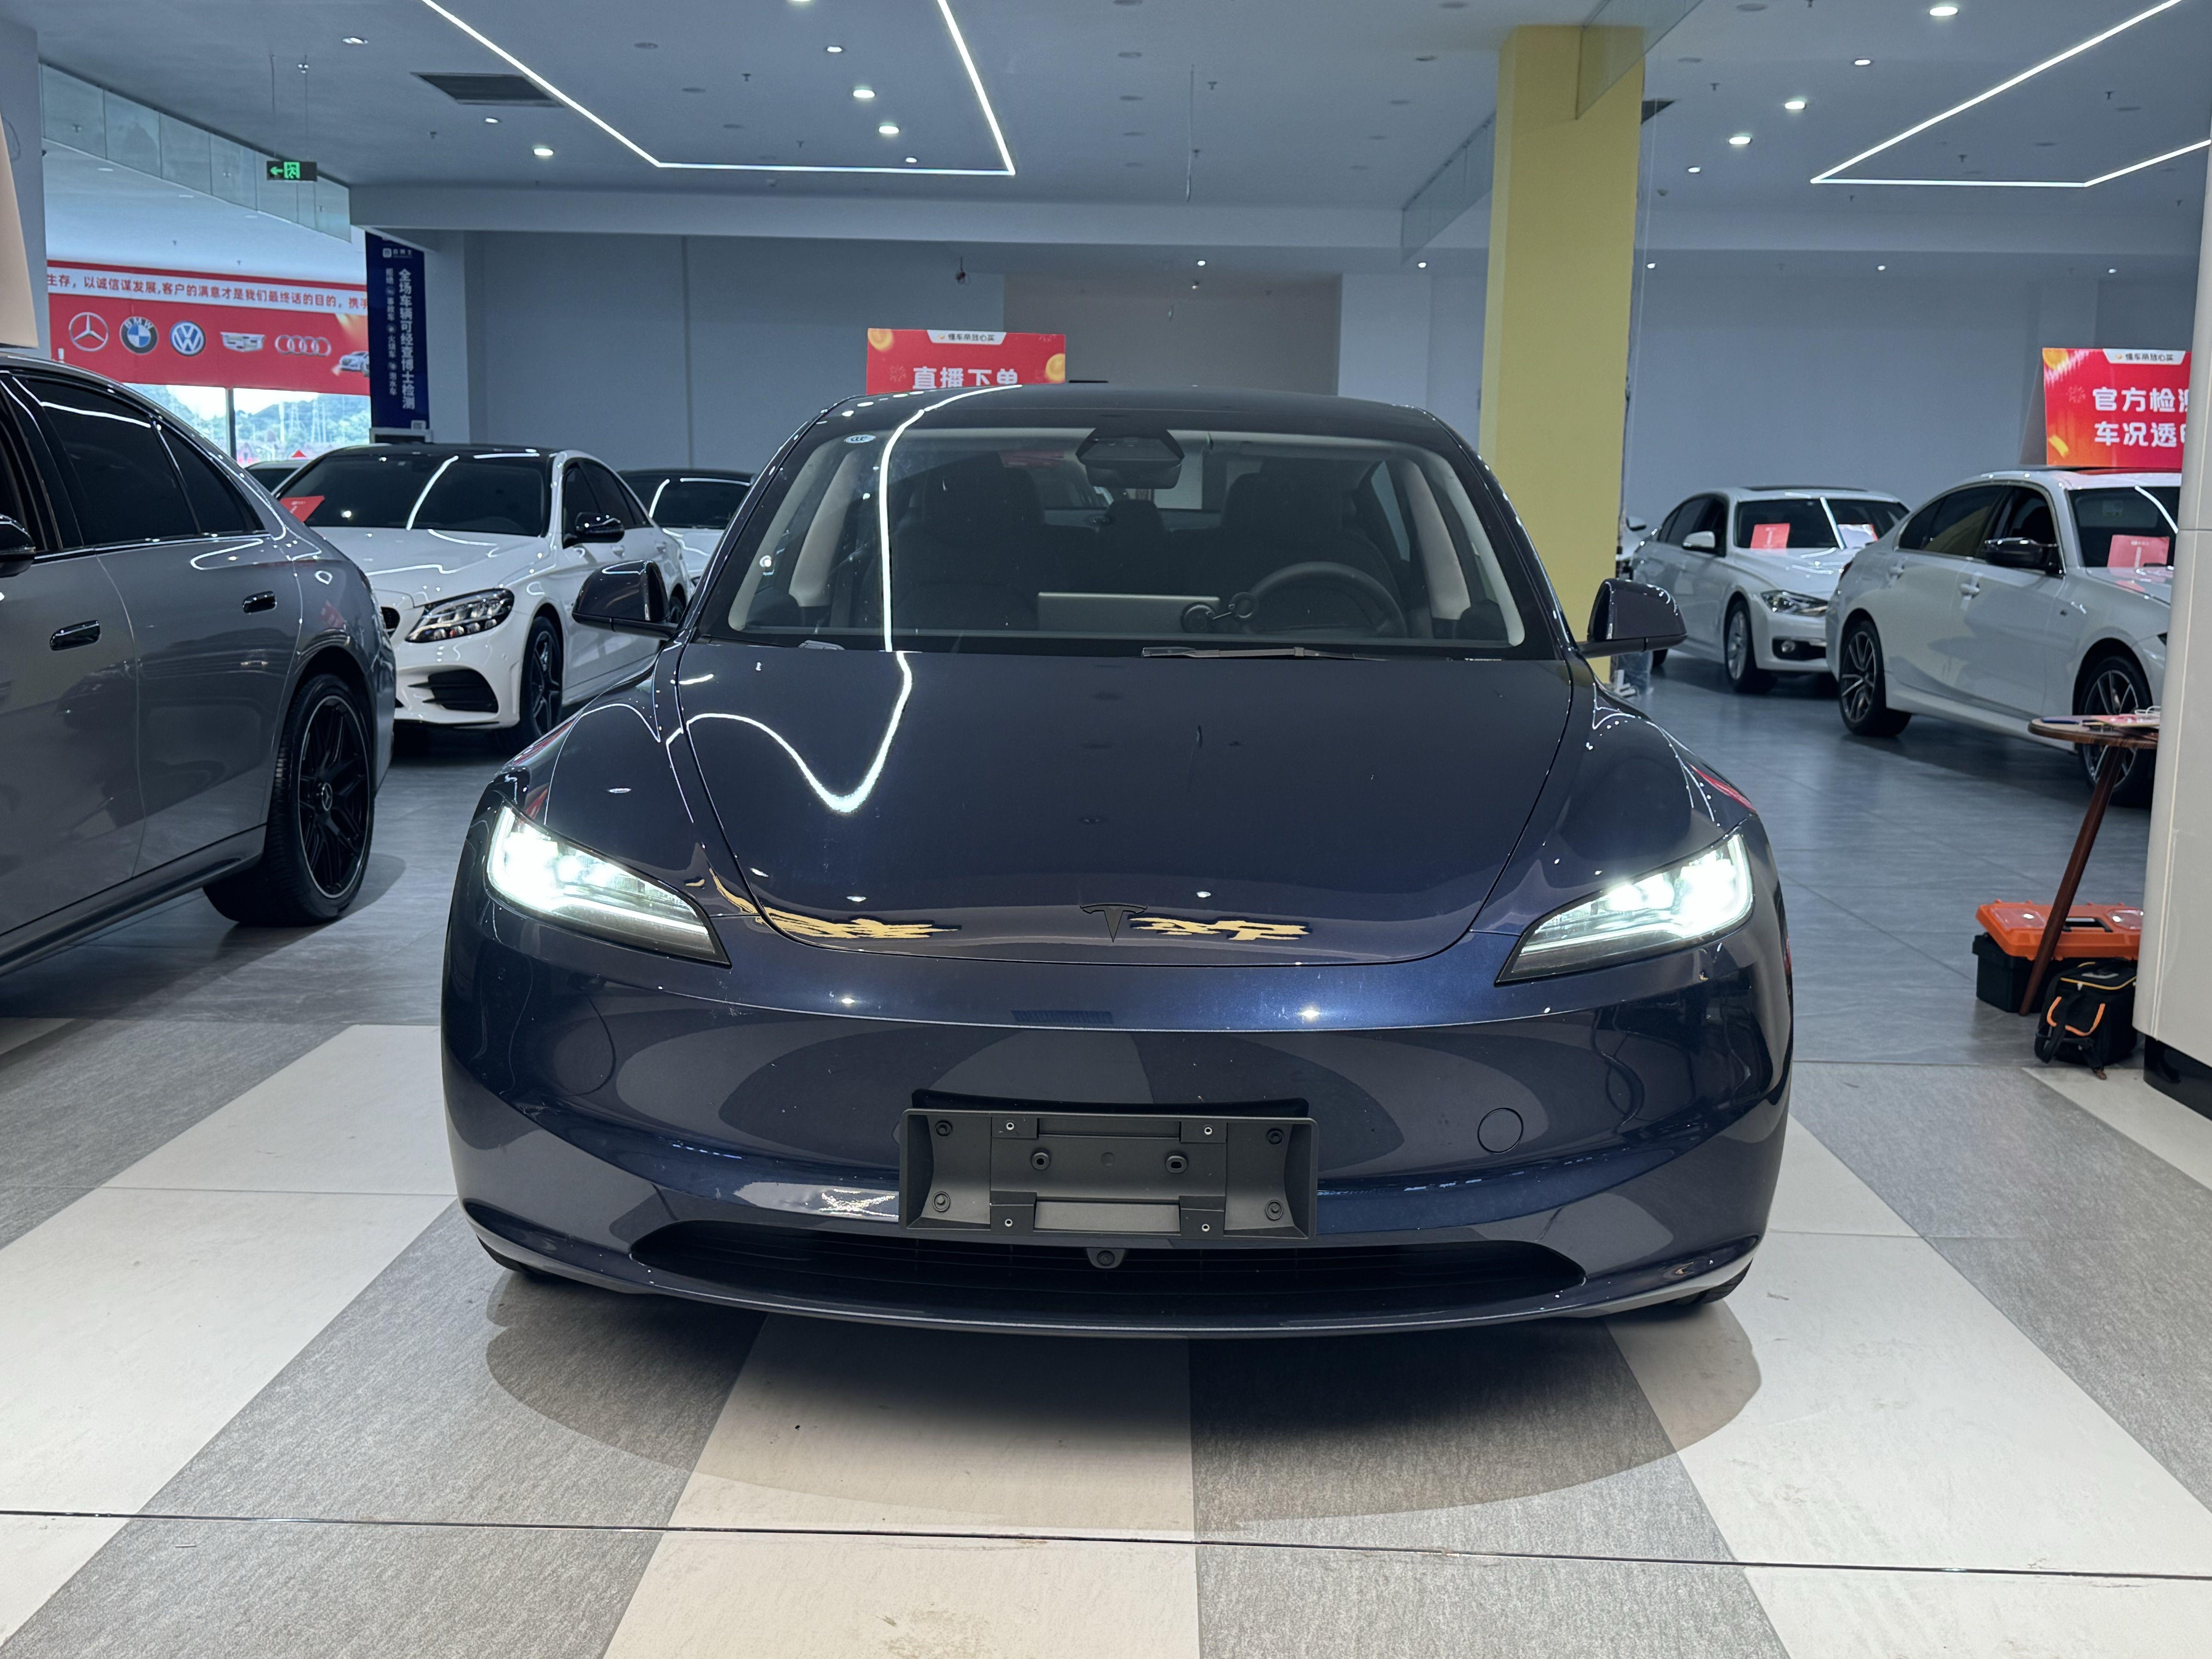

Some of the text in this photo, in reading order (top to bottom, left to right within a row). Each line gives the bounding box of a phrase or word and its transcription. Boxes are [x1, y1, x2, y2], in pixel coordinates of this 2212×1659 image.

[124, 317, 154, 329] BMW
[912, 366, 1018, 389] 直播下单
[2094, 421, 2186, 447] 车况透
